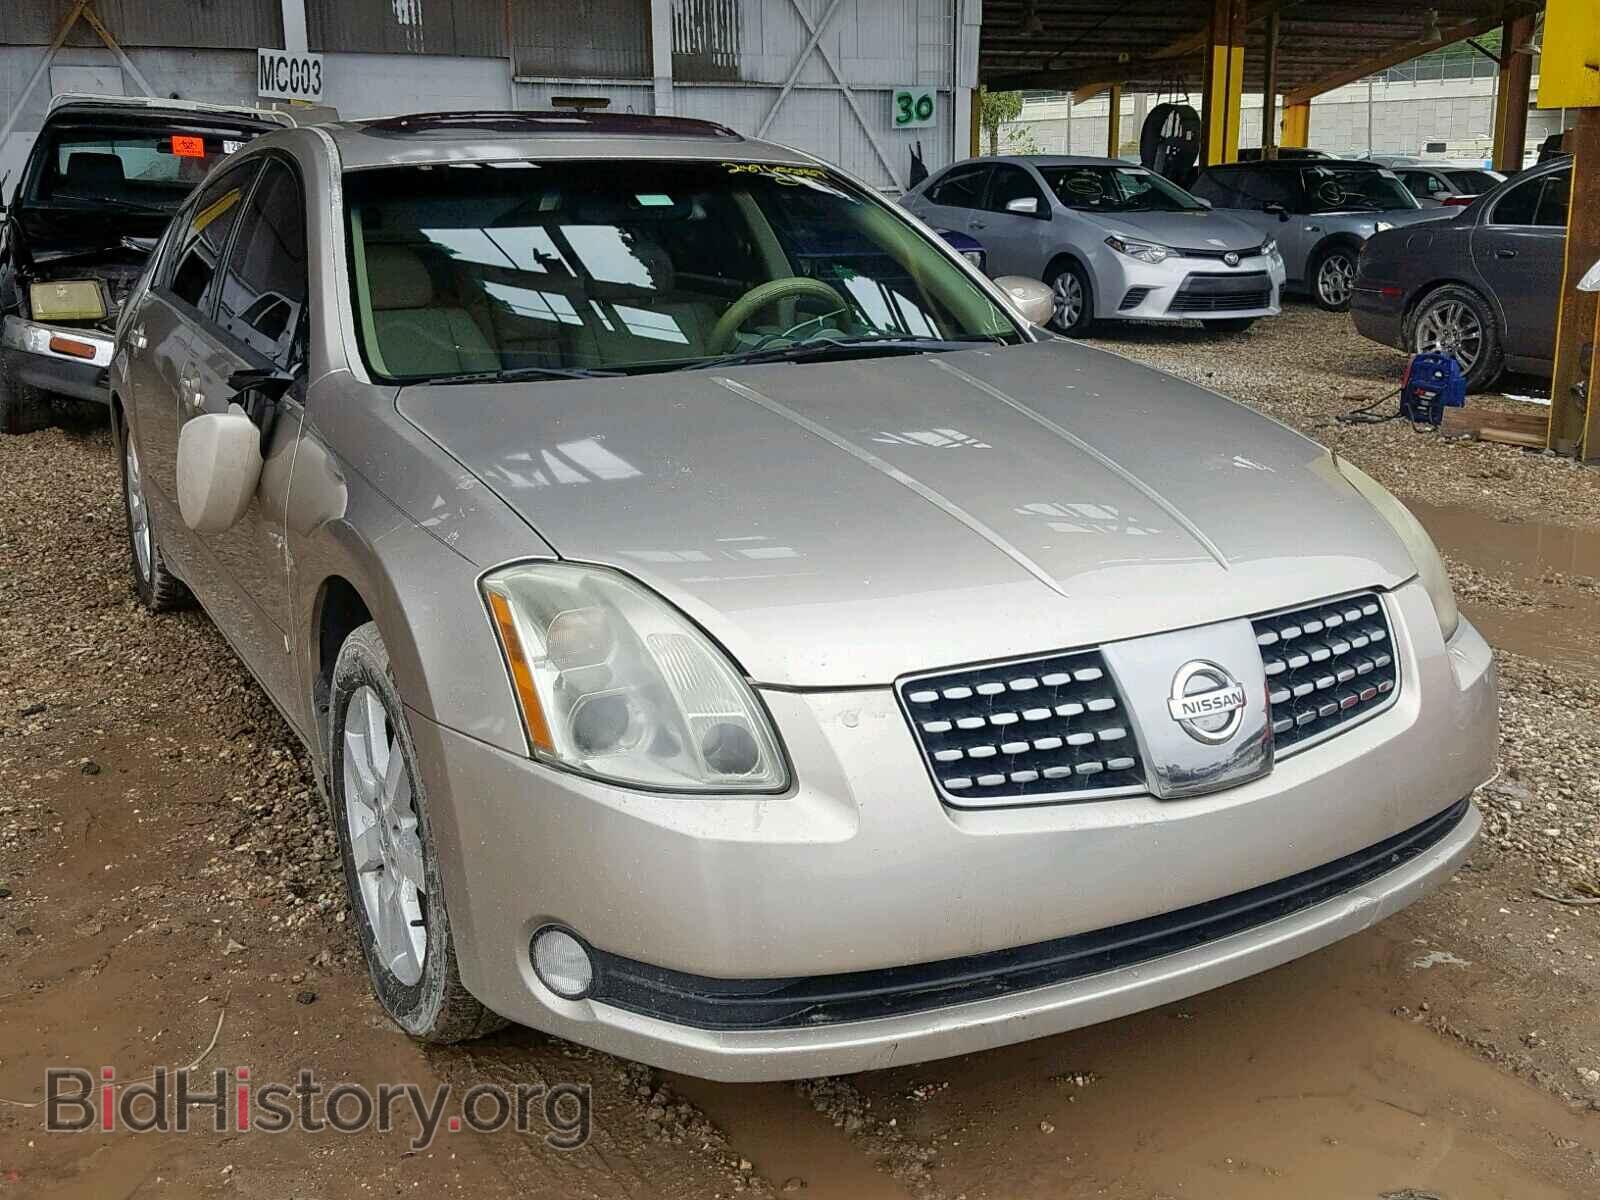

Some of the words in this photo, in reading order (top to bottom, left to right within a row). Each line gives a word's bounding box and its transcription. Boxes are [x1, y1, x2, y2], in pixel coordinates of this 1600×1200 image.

[261, 55, 321, 95] MC003
[896, 93, 933, 124] 30
[1182, 691, 1241, 715] NISSAN
